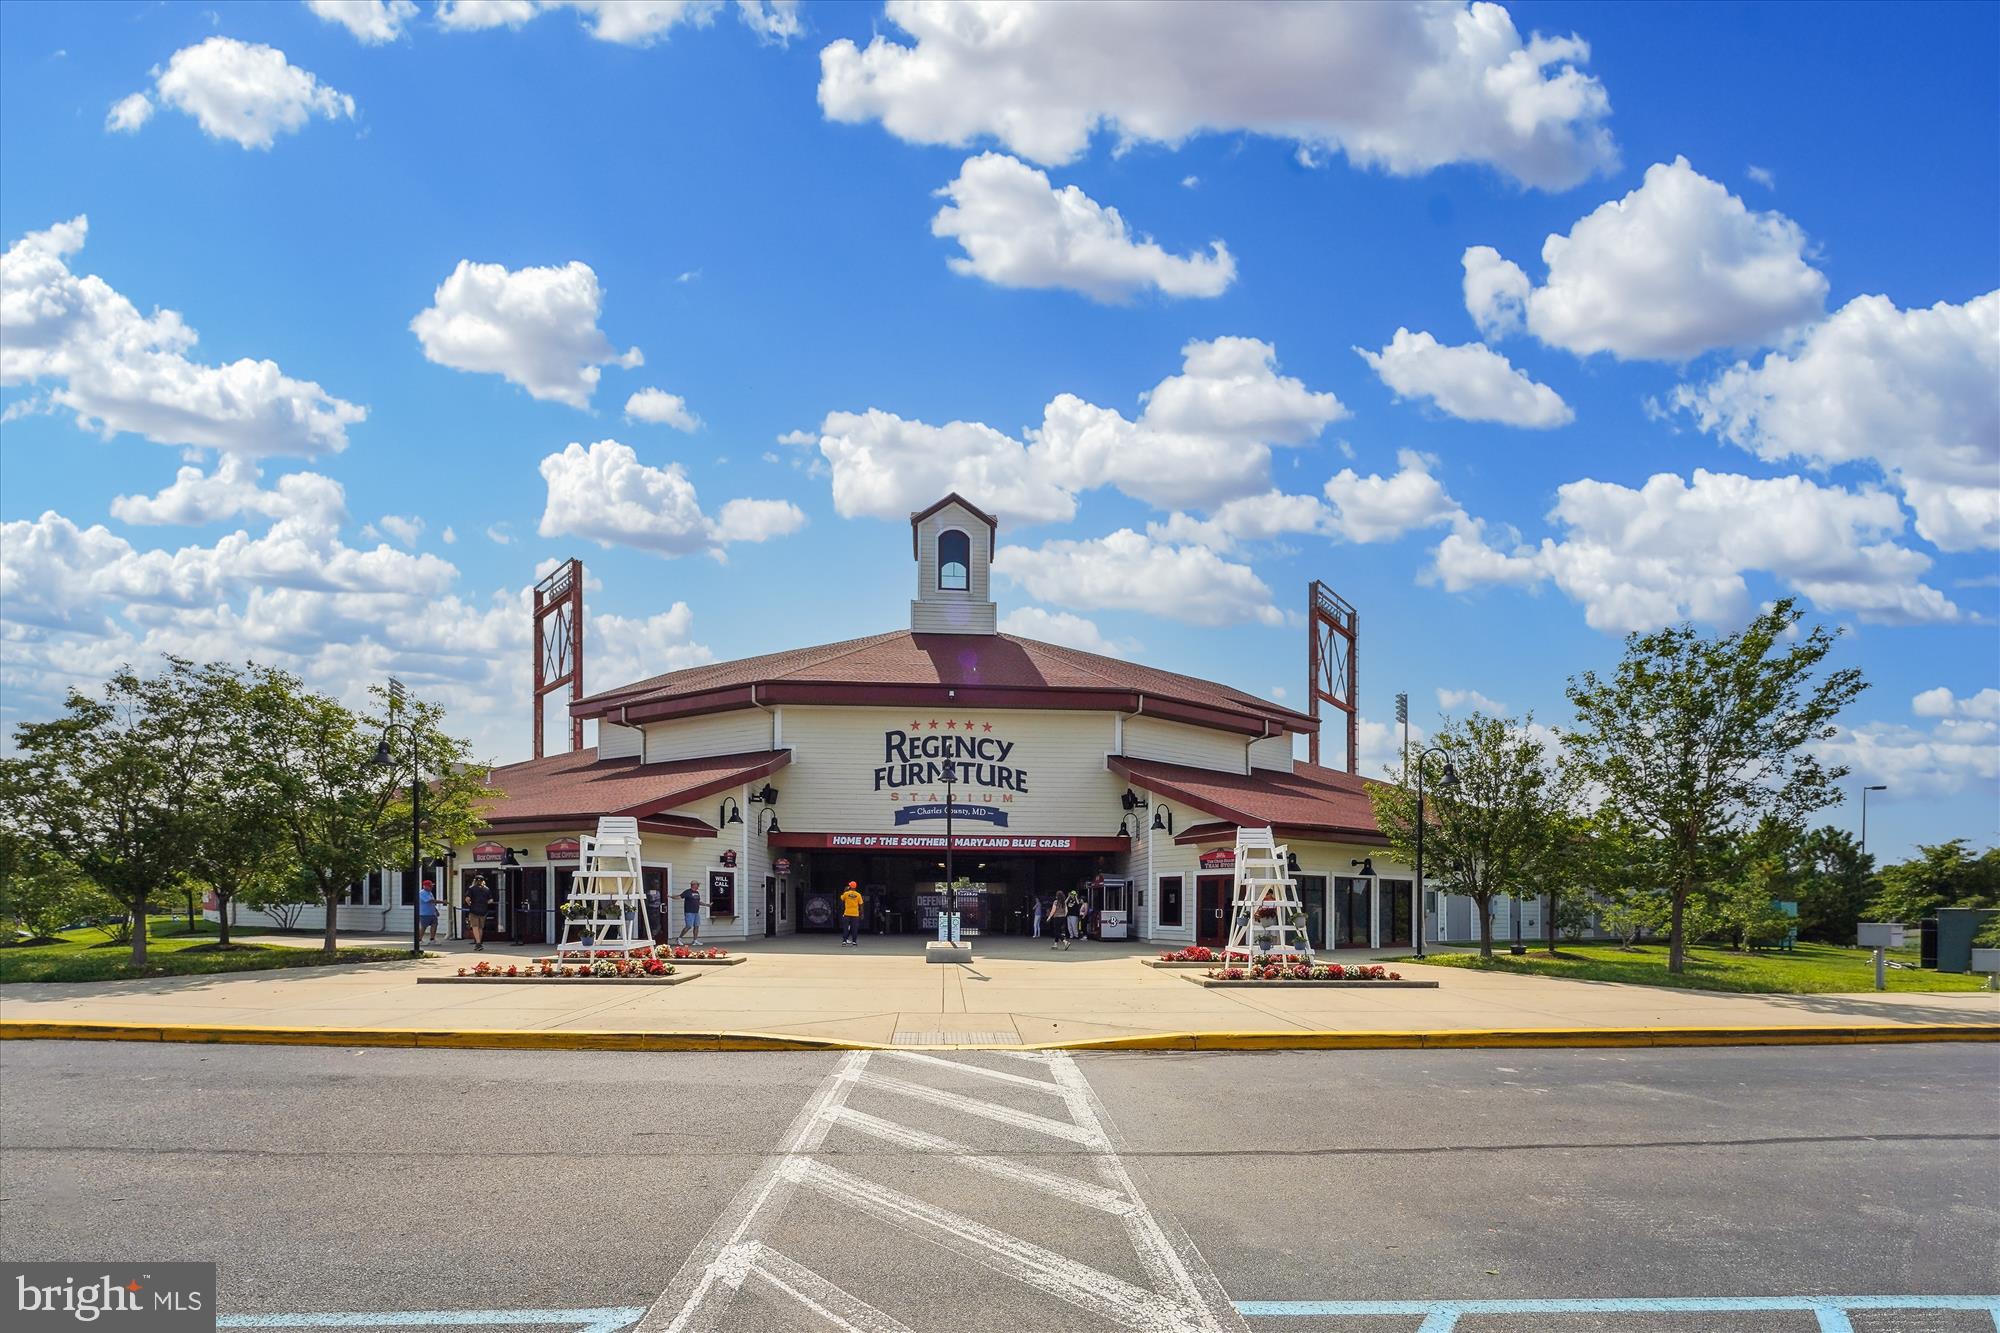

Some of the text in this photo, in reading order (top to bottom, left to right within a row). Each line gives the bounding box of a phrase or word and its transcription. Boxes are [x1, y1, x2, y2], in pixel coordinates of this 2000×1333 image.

[891, 792, 1013, 803] STADIUM
[917, 807, 942, 815] Charles
[972, 808, 987, 816] MD
[833, 836, 862, 845] HOME
[864, 837, 877, 845] OF
[880, 837, 899, 846] THE
[954, 838, 1010, 847] MARYLAND
[1012, 839, 1037, 848] BLUE
[1039, 839, 1070, 848] CRABS
[917, 895, 947, 906] DEFEND
[924, 906, 940, 917] THE
